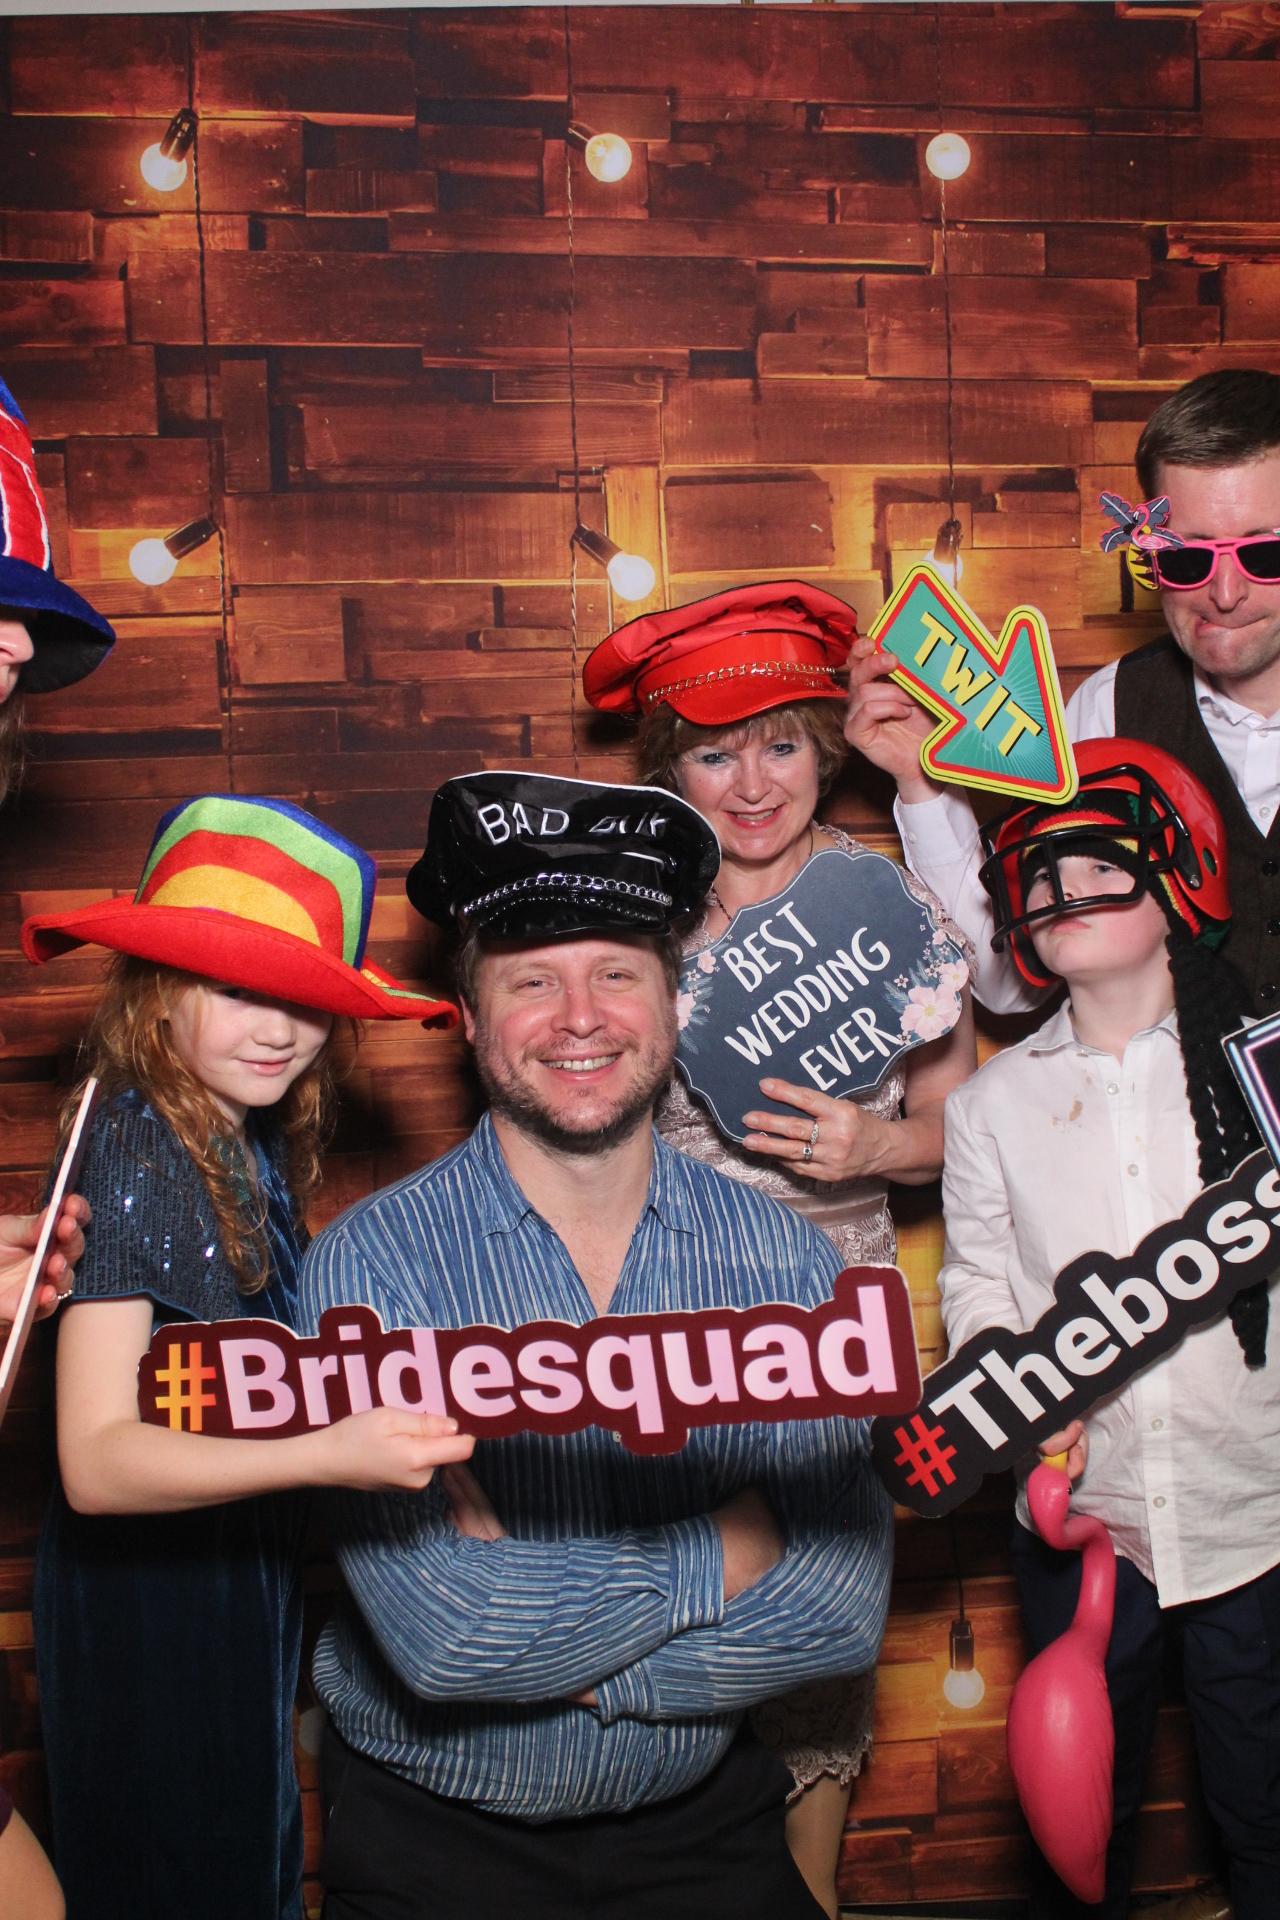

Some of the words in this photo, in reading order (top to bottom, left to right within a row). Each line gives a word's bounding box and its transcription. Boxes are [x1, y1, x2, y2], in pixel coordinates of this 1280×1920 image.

[913, 611, 1043, 757] TWIT
[477, 802, 570, 846] BAD
[722, 901, 818, 992] BEST
[724, 926, 891, 1065] WEDDING
[799, 1007, 903, 1091] EVER
[154, 1285, 898, 1434] #Bridesquad
